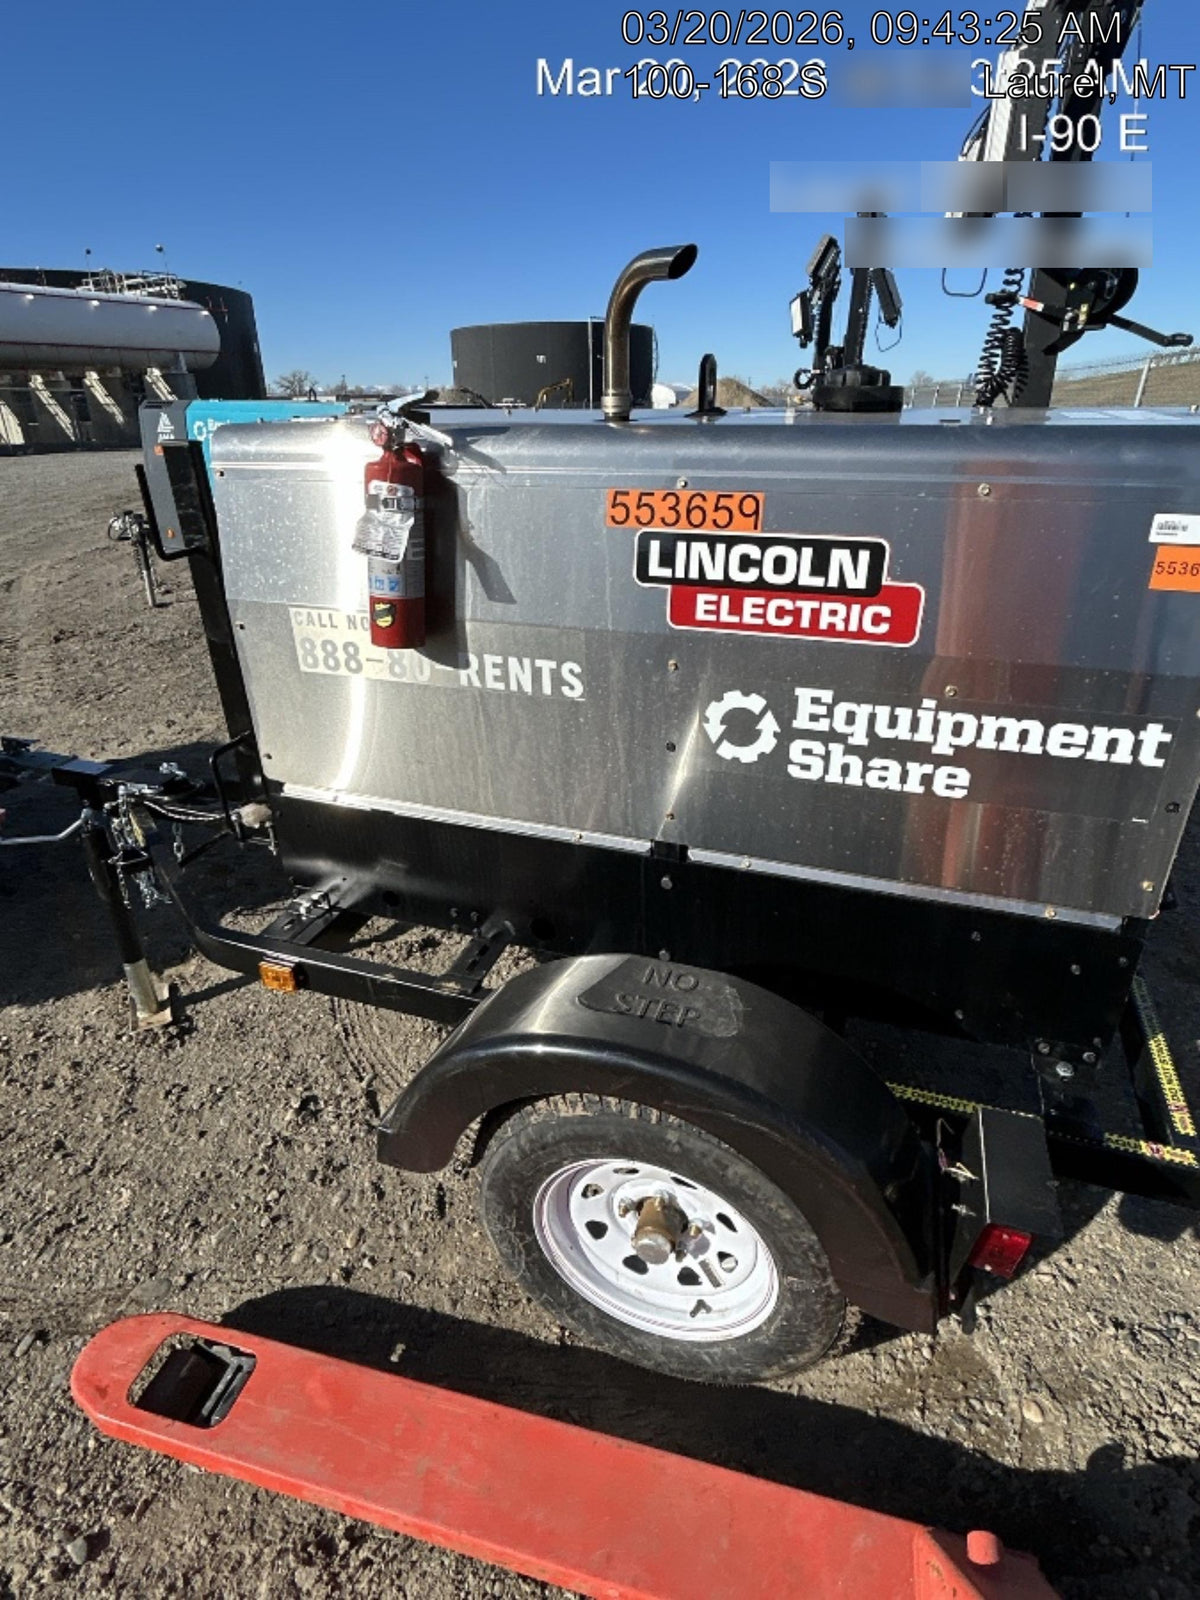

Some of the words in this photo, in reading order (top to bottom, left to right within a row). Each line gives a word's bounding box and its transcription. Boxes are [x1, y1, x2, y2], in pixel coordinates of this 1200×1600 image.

[609, 490, 762, 531] 553659
[648, 539, 871, 590] LINCOLN
[1155, 561, 1200, 577] 5536
[294, 610, 338, 629] CALL
[346, 614, 370, 632] NO
[695, 593, 892, 634] ELECTRIC
[792, 687, 1173, 769] Equipment
[786, 739, 972, 799] Share
[642, 965, 700, 992] NO
[612, 992, 701, 1028] STEP
